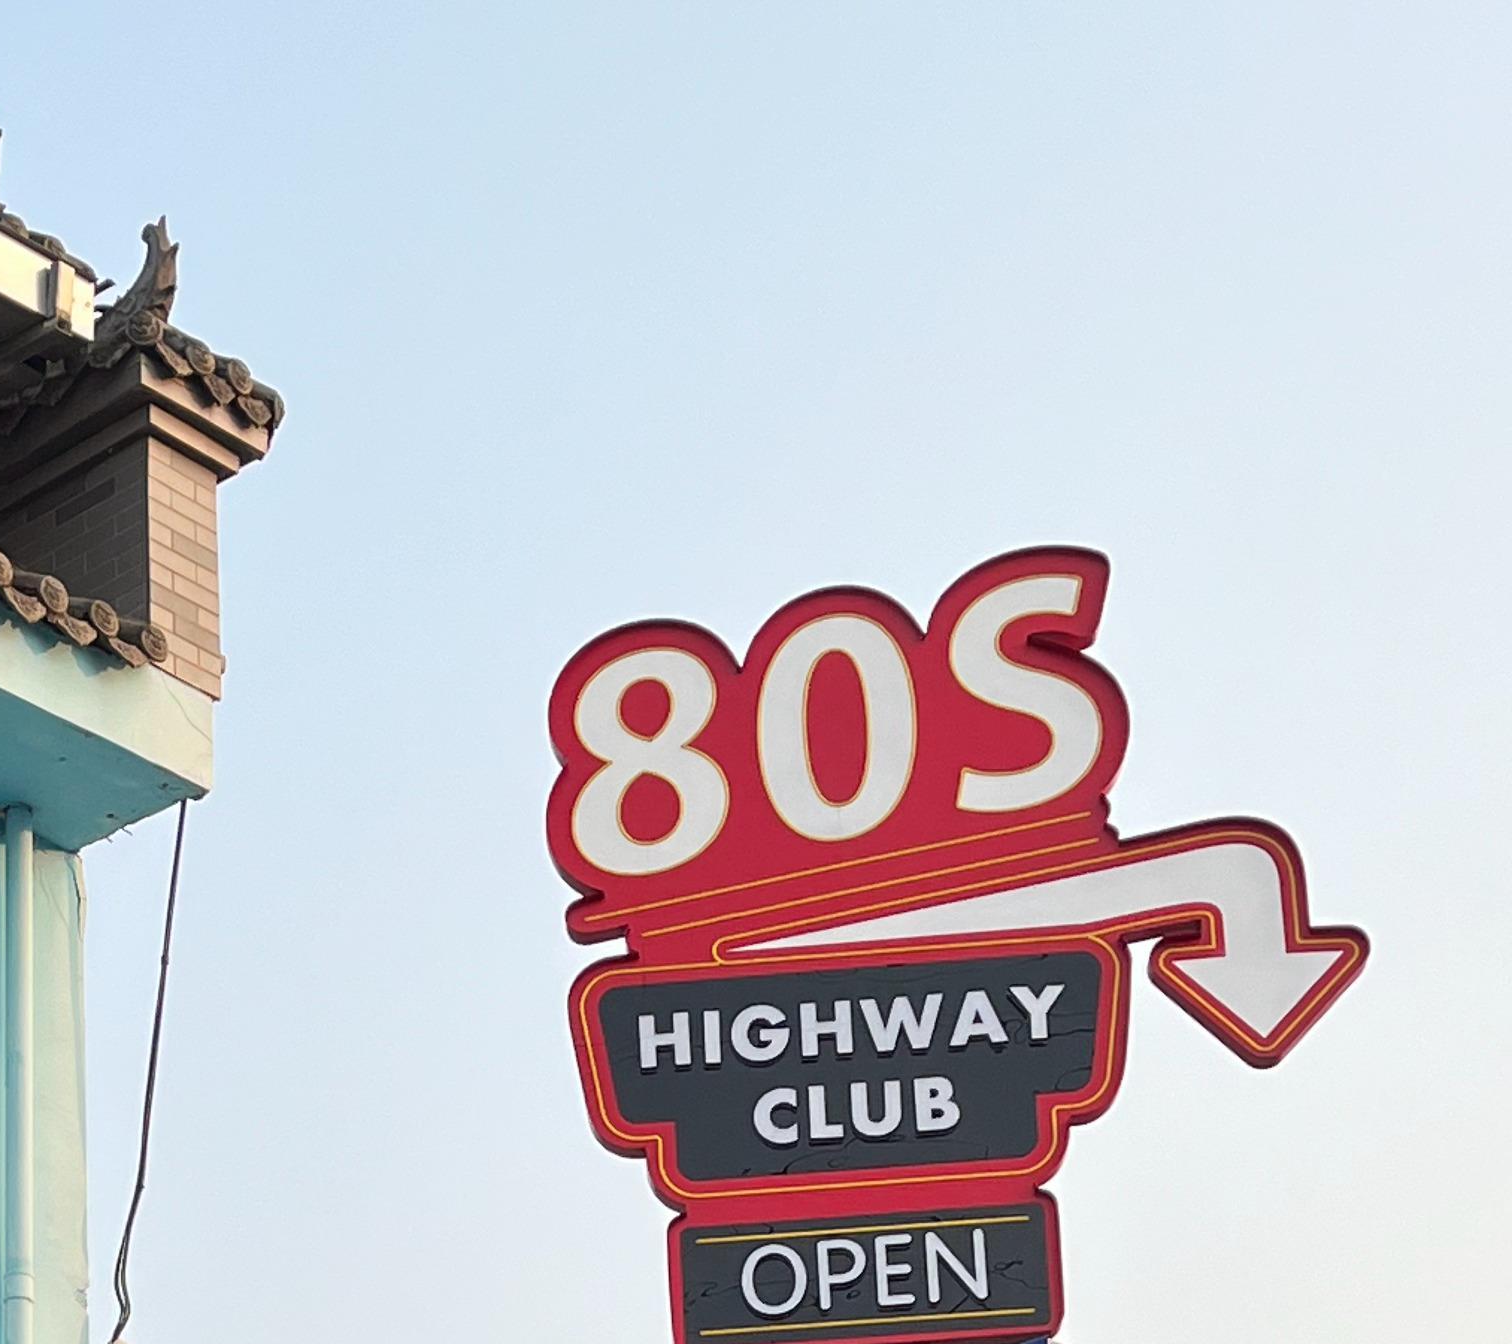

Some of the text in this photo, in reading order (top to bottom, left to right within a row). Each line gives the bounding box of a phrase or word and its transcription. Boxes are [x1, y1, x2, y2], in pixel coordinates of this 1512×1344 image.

[571, 574, 1102, 877] 80S
[636, 983, 1065, 1070] HIGHWAY
[752, 1075, 962, 1145] CLUB
[740, 1228, 990, 1319] OPEN
